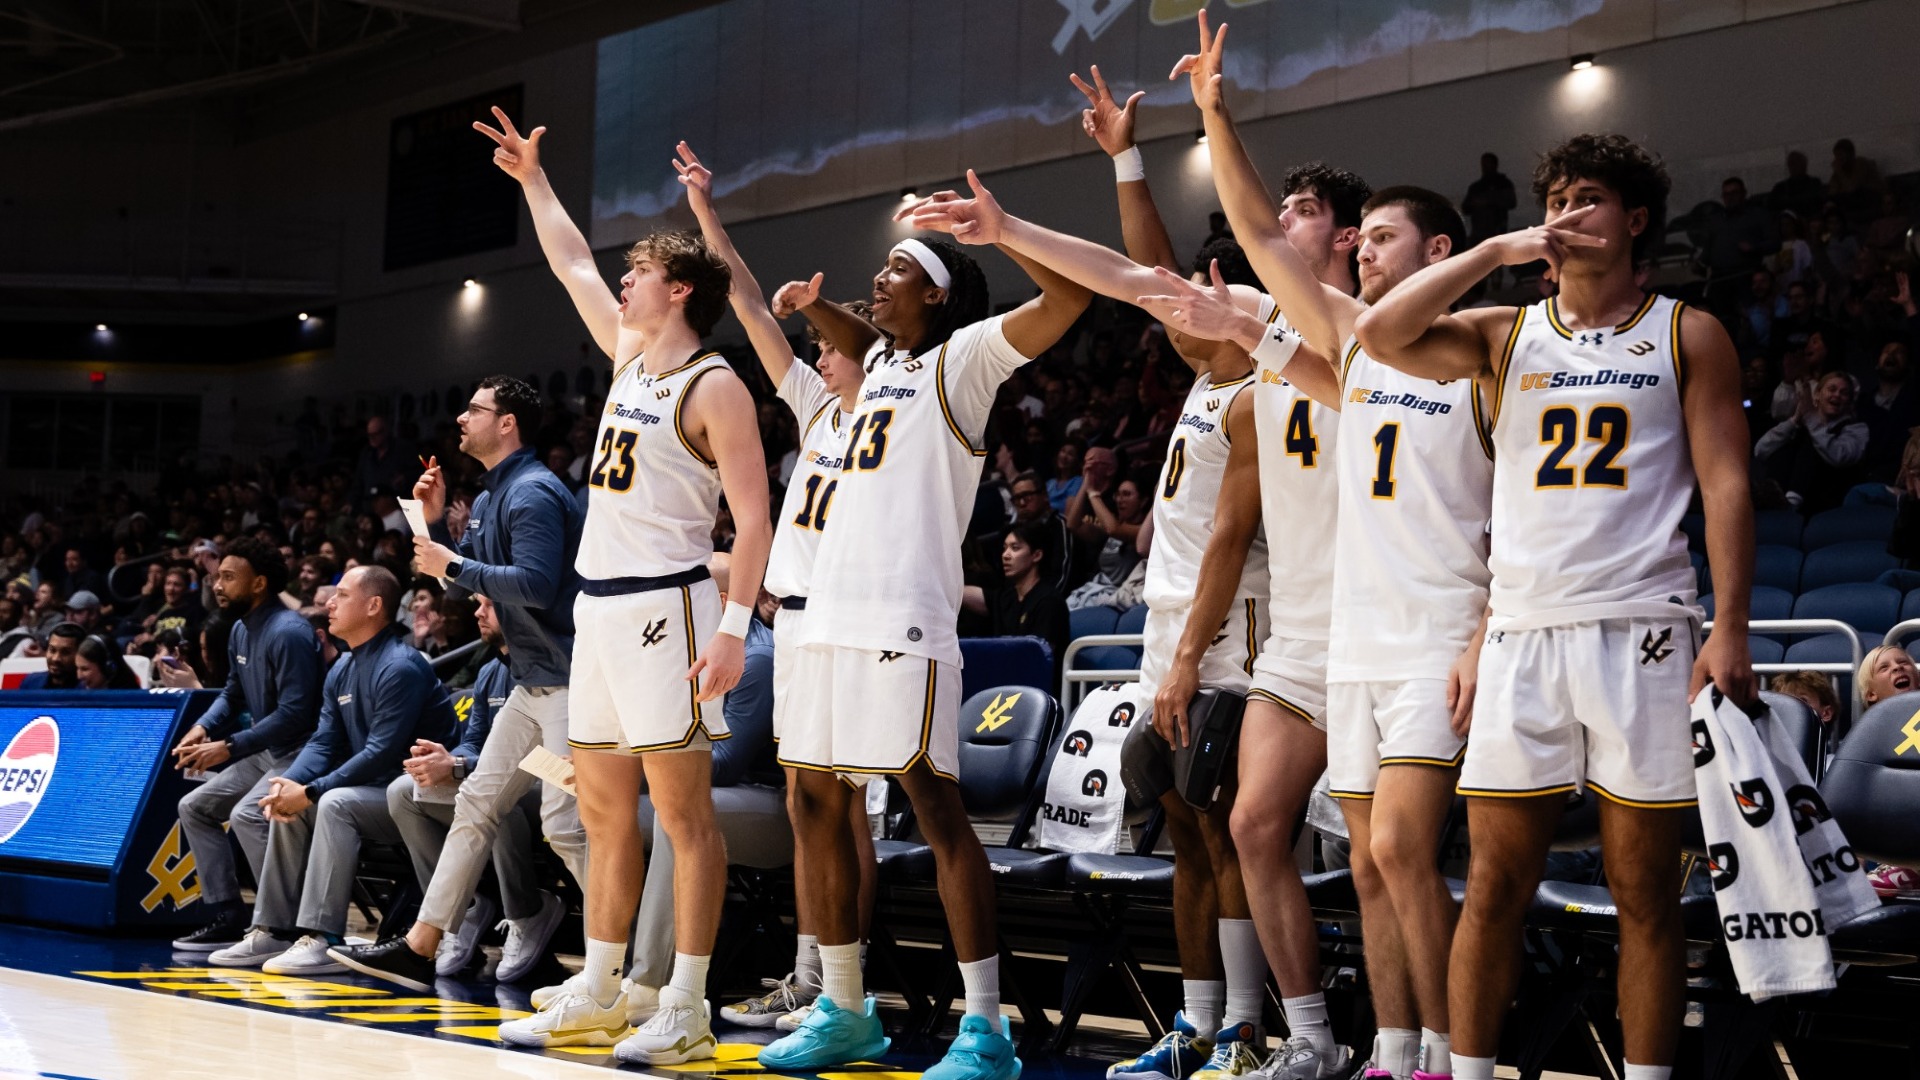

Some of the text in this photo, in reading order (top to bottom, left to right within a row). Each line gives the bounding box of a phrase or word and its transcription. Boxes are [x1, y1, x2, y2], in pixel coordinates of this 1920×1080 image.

[589, 426, 641, 494] 23
[842, 406, 896, 473] 13
[1284, 397, 1320, 469] 4
[1371, 421, 1401, 500] 1
[1534, 403, 1631, 491] 22
[1162, 435, 1187, 501] 0
[792, 472, 838, 536] 10
